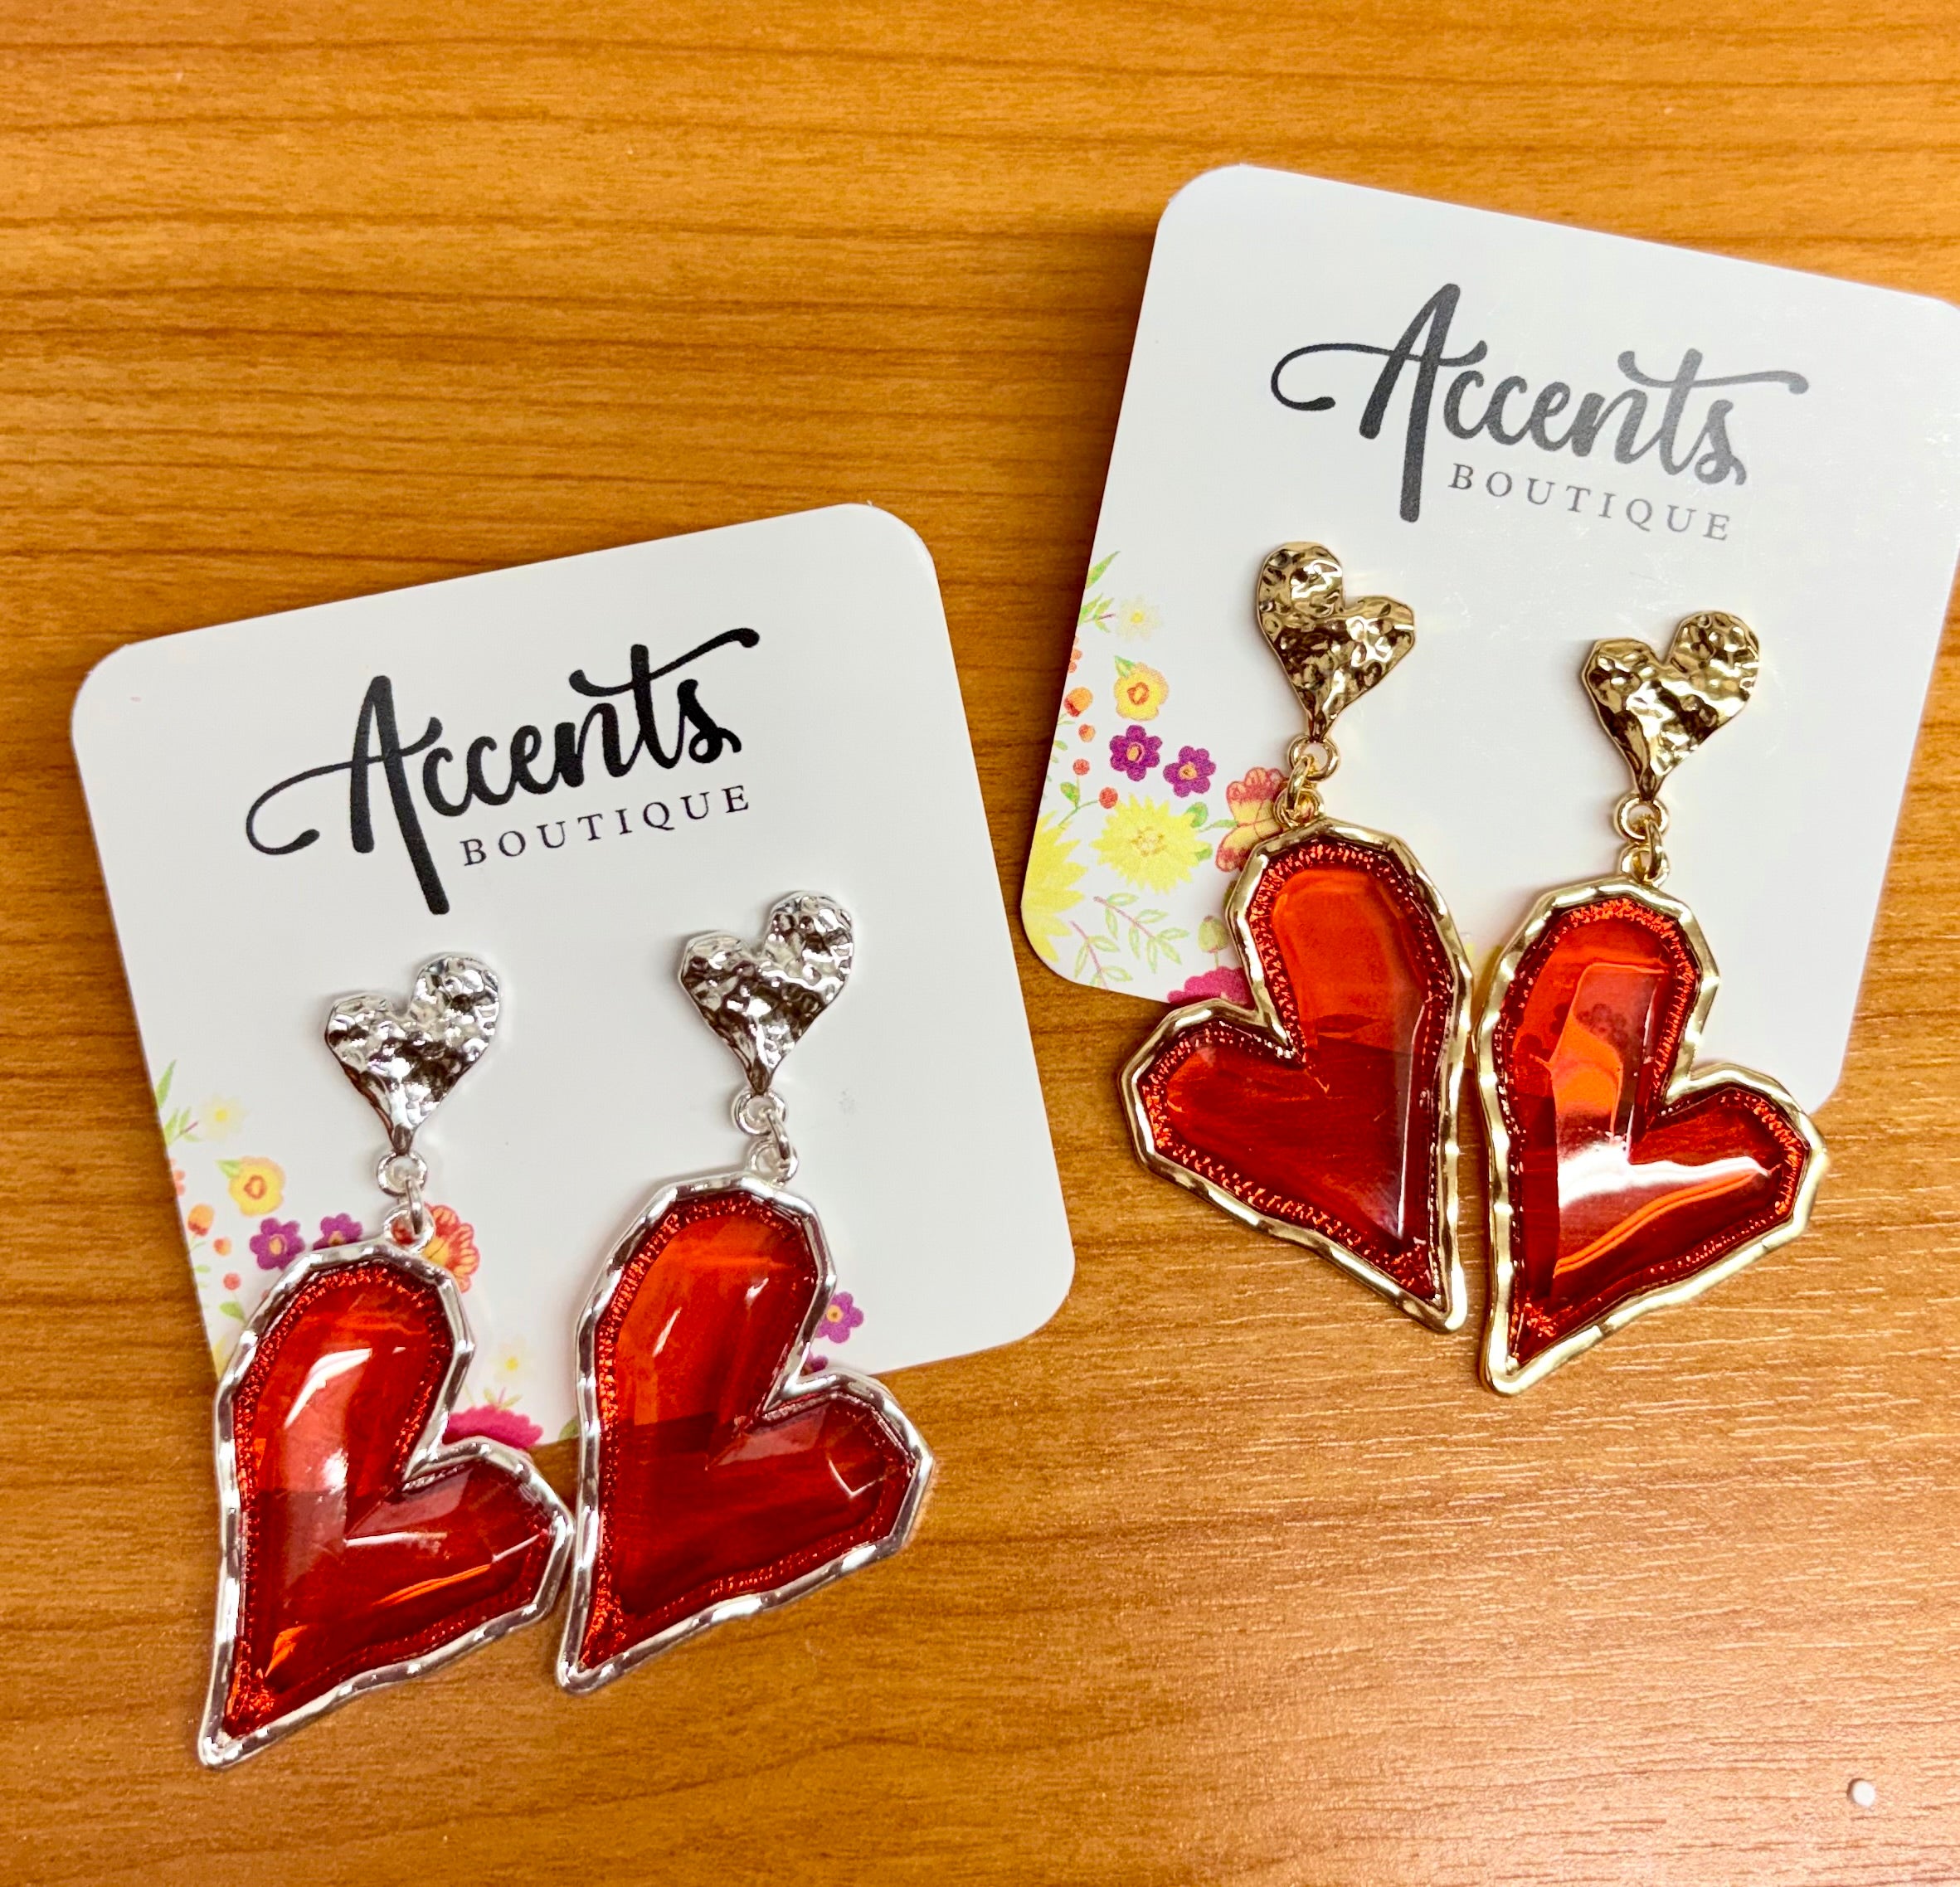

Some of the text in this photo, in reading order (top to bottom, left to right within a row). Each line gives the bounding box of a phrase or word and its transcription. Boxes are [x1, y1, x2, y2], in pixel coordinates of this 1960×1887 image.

[1271, 284, 1809, 523] Accents
[1448, 463, 1731, 542] BOUTIQUE
[246, 628, 761, 916] Accents
[460, 785, 751, 866] BOUTIQUE
